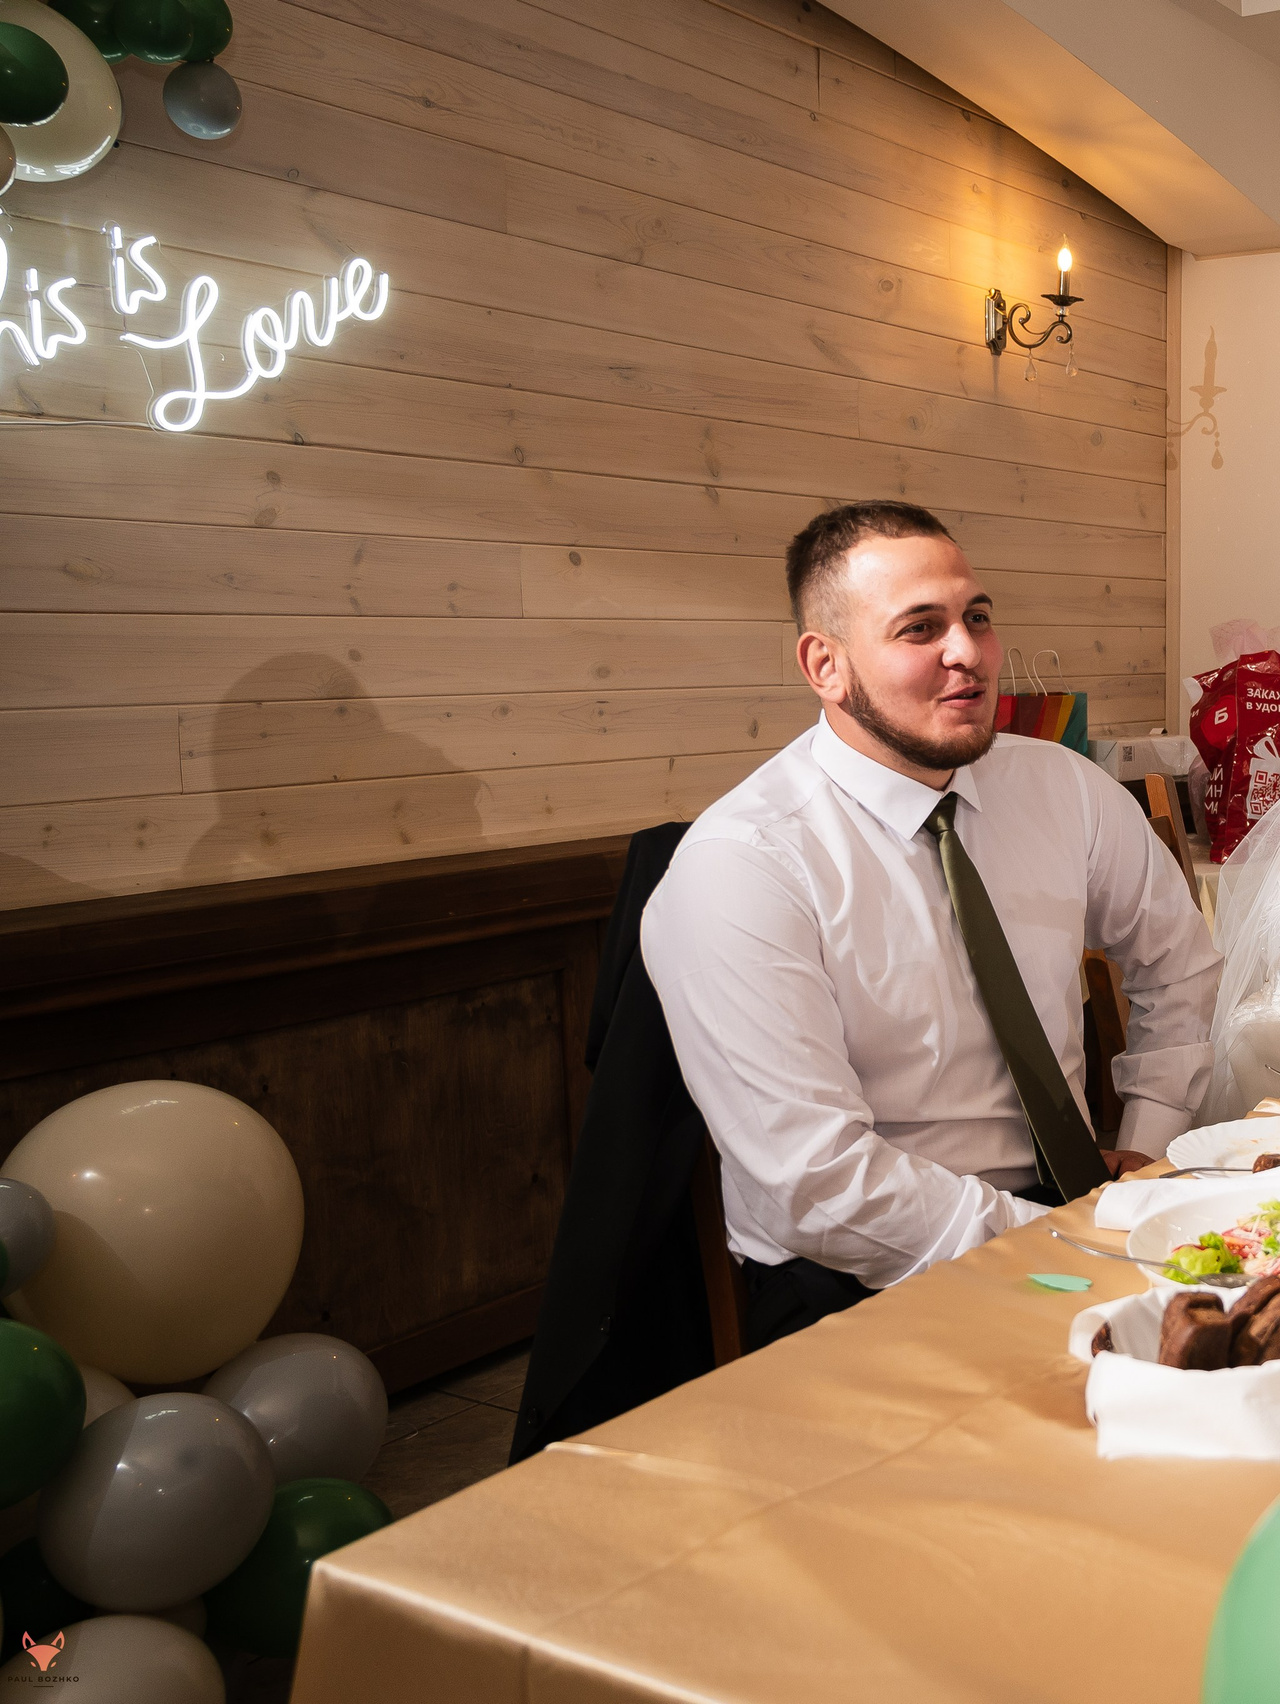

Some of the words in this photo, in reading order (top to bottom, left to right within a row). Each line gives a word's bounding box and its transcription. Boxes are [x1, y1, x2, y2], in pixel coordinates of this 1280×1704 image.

[109, 226, 167, 315] is
[119, 257, 390, 432] Love
[1246, 702, 1253, 710] В
[1214, 706, 1229, 725] Б
[1205, 784, 1223, 798] ИН
[1203, 801, 1219, 815] МА
